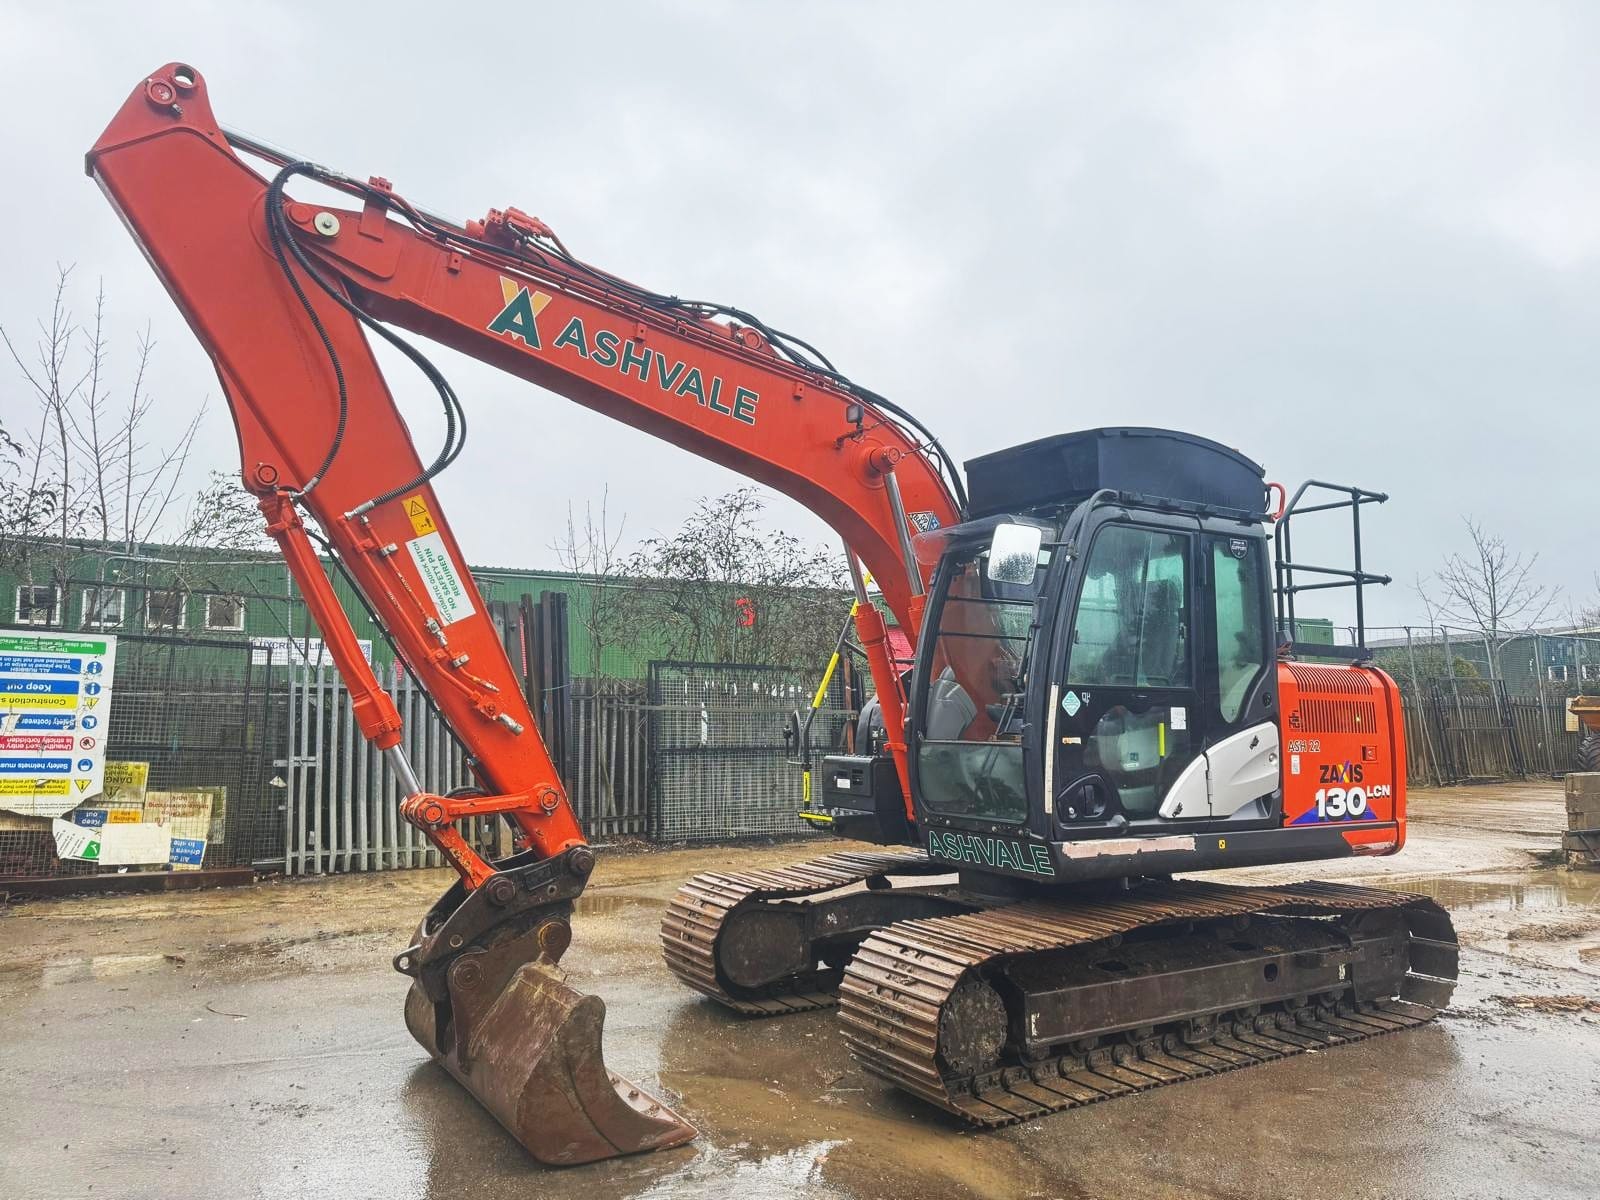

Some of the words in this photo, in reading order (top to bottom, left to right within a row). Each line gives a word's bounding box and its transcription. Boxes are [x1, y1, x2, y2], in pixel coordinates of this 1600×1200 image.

[553, 316, 759, 426] ASHVALE
[411, 541, 425, 563] HITCH
[423, 547, 436, 564] PIN
[422, 562, 436, 585] QUICK
[431, 565, 452, 597] SAFETY
[437, 554, 460, 597] REQUIRED
[432, 584, 453, 622] AUTOMATIC
[447, 597, 457, 610] NO
[26, 683, 52, 692] Keep
[9, 697, 66, 706] Construction
[21, 718, 51, 726] footwear
[53, 717, 75, 727] Safety
[5, 742, 25, 750] entry
[1288, 740, 1307, 752] ASH
[1309, 740, 1321, 752] 22
[46, 762, 68, 770] Safety
[1320, 760, 1364, 784] ZAXIS
[104, 776, 133, 784] DANG
[1315, 786, 1367, 820] 130
[1366, 784, 1391, 799] LCN
[928, 830, 1055, 876] ASHVALE
